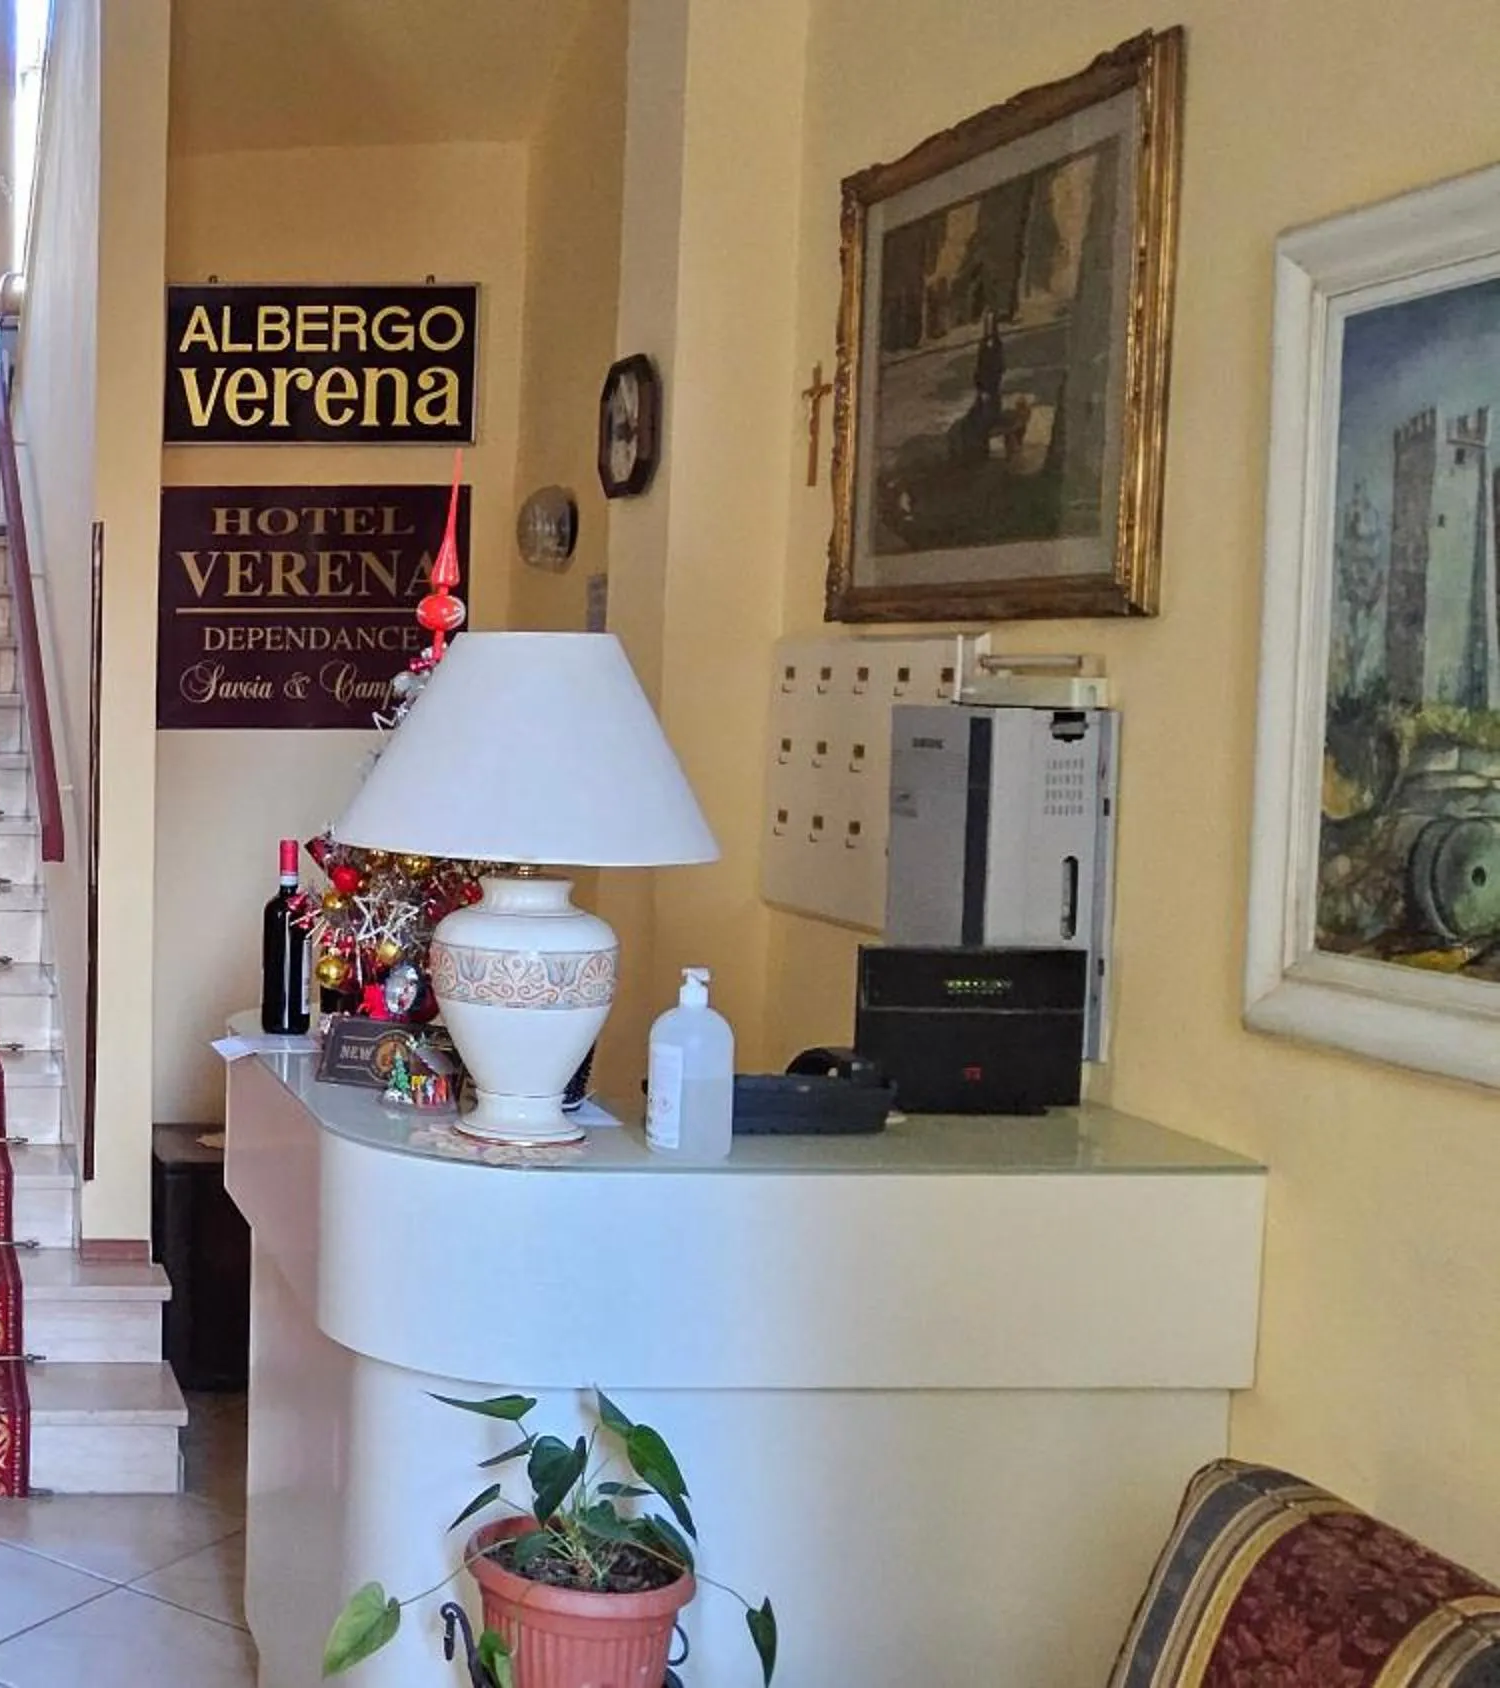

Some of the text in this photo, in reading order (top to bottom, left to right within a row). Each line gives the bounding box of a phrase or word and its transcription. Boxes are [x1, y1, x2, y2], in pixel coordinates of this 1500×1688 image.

[179, 305, 465, 353] ALBERGO
[179, 367, 461, 427] verena
[212, 507, 414, 535] HOTEL
[176, 550, 437, 599] VERENA
[204, 626, 421, 652] DEPENDANCE
[180, 659, 274, 703] Savoia
[283, 671, 311, 699] &
[339, 1044, 375, 1060] NEW
